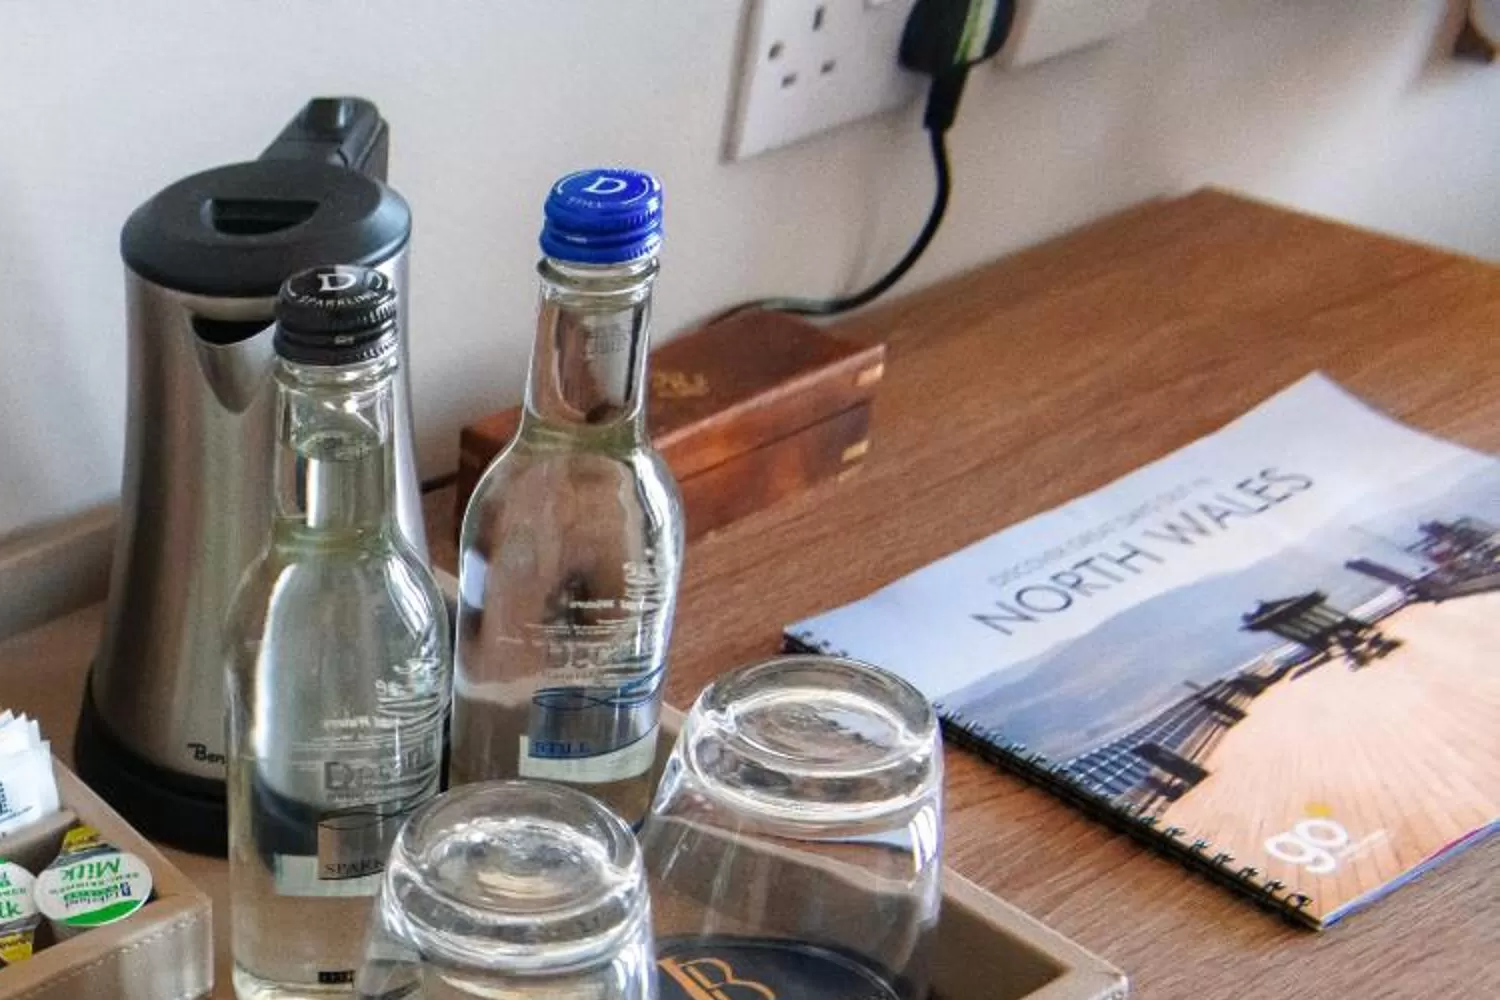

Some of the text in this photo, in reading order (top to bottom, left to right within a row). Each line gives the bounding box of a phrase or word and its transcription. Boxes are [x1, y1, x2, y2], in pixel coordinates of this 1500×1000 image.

[317, 272, 357, 292] D
[969, 467, 1315, 635] NORTH WALES
[1263, 816, 1349, 874] go
[61, 857, 121, 881] Milk
[325, 857, 385, 876] SPARK
